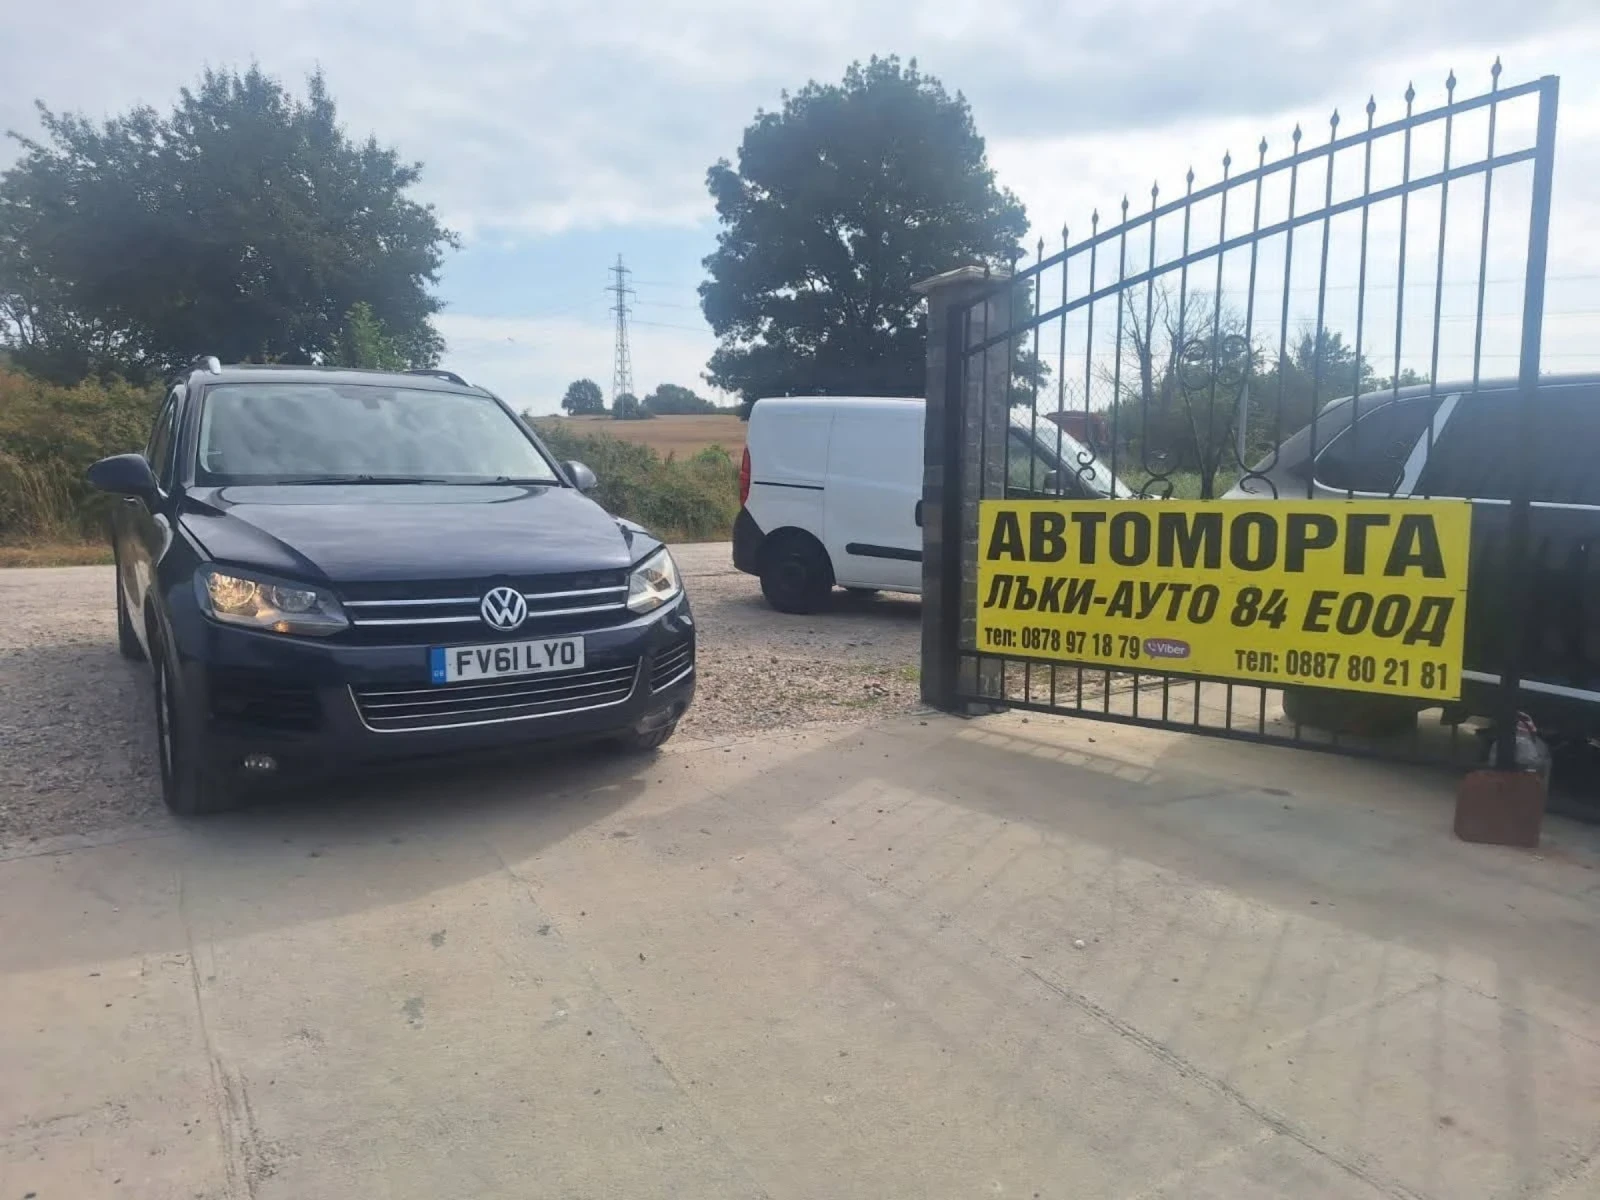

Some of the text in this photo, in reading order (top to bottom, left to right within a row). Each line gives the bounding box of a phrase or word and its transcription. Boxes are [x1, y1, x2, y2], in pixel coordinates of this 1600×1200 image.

[986, 511, 1446, 578] АВТОМОРГА
[983, 574, 1455, 647] ЛЪКИ-АУТО 84 ЕООД
[456, 641, 575, 676] FV61 LYO
[984, 626, 1140, 660] тел: 0878 97 18 79
[1156, 642, 1186, 655] Viber
[1235, 649, 1447, 691] тел: 0887 80 21 81
